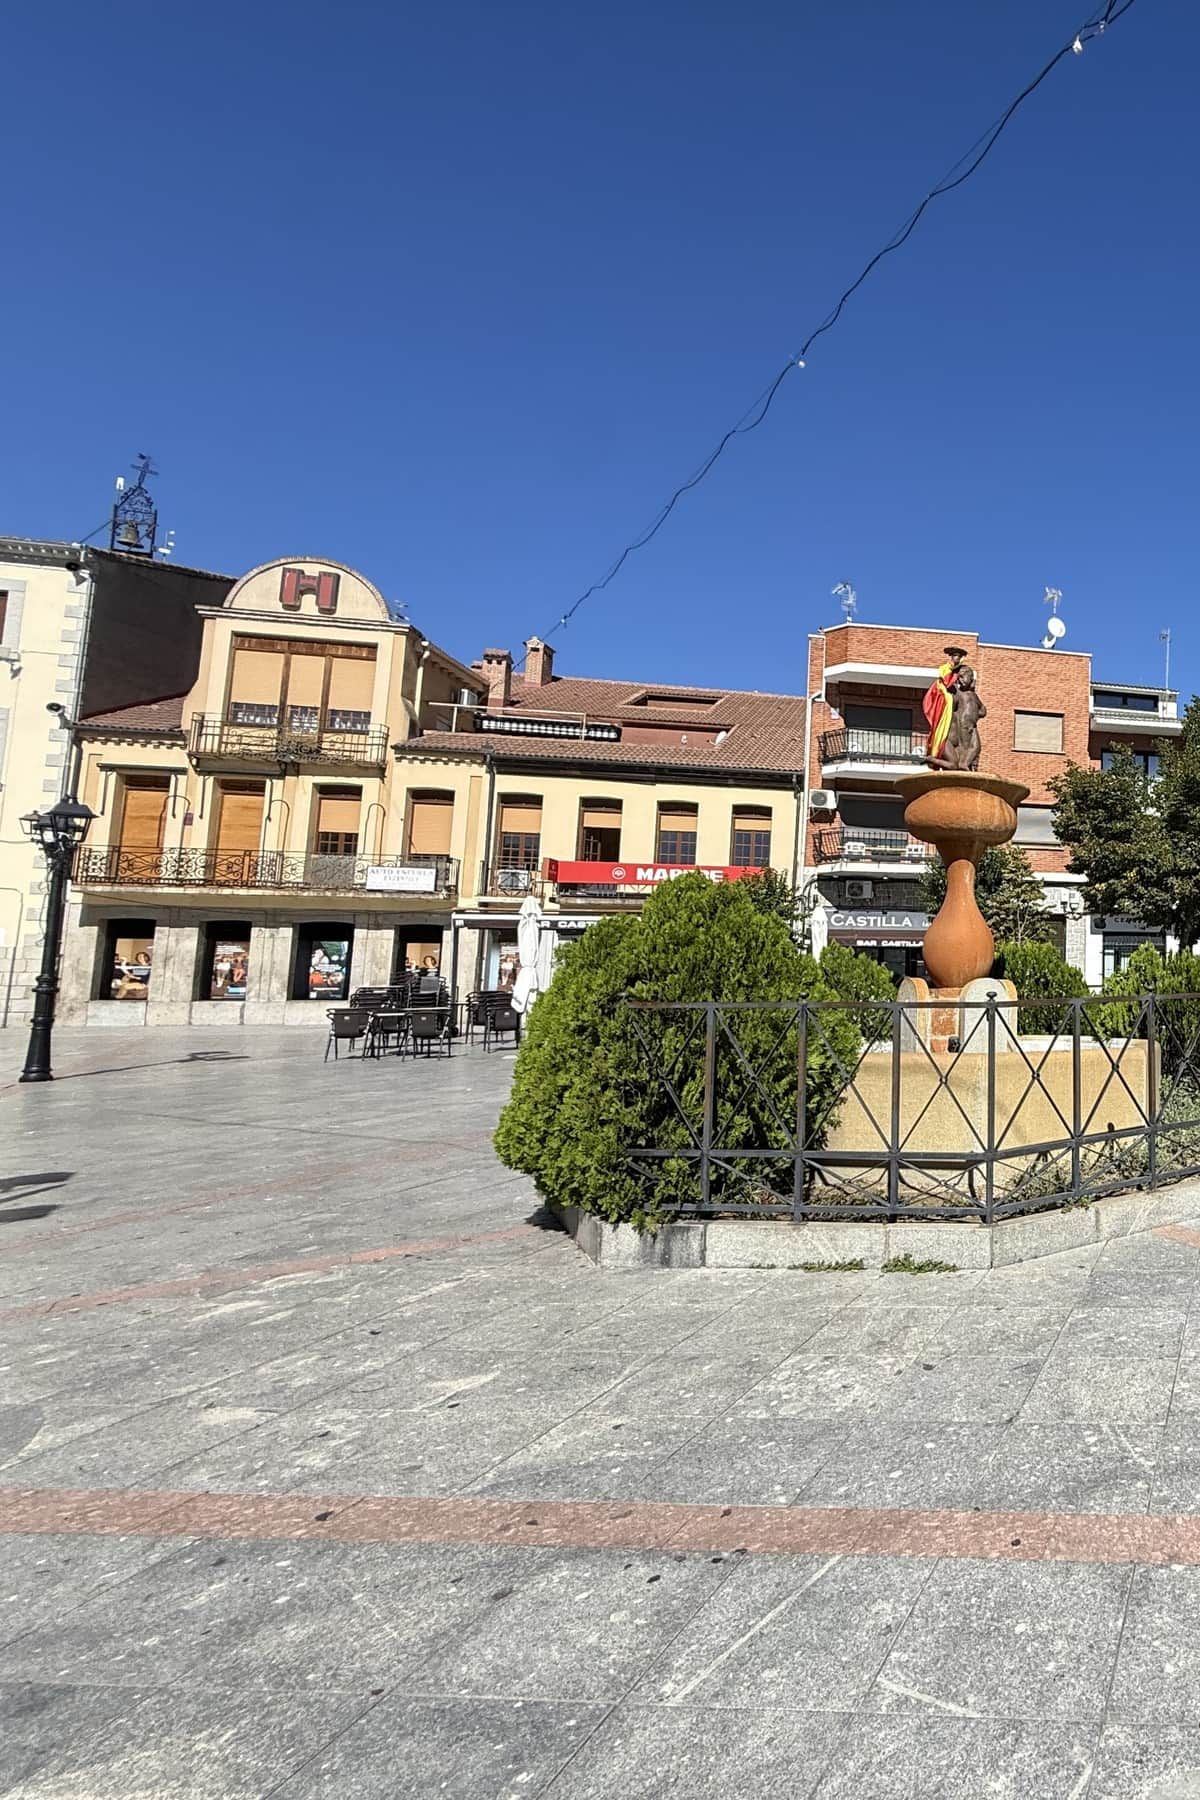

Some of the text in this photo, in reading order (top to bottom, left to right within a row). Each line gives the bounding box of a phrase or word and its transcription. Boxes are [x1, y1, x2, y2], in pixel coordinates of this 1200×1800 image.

[636, 867, 724, 882] MAPE
[830, 913, 913, 928] CASTILLA
[881, 940, 924, 948] CASTILLA
